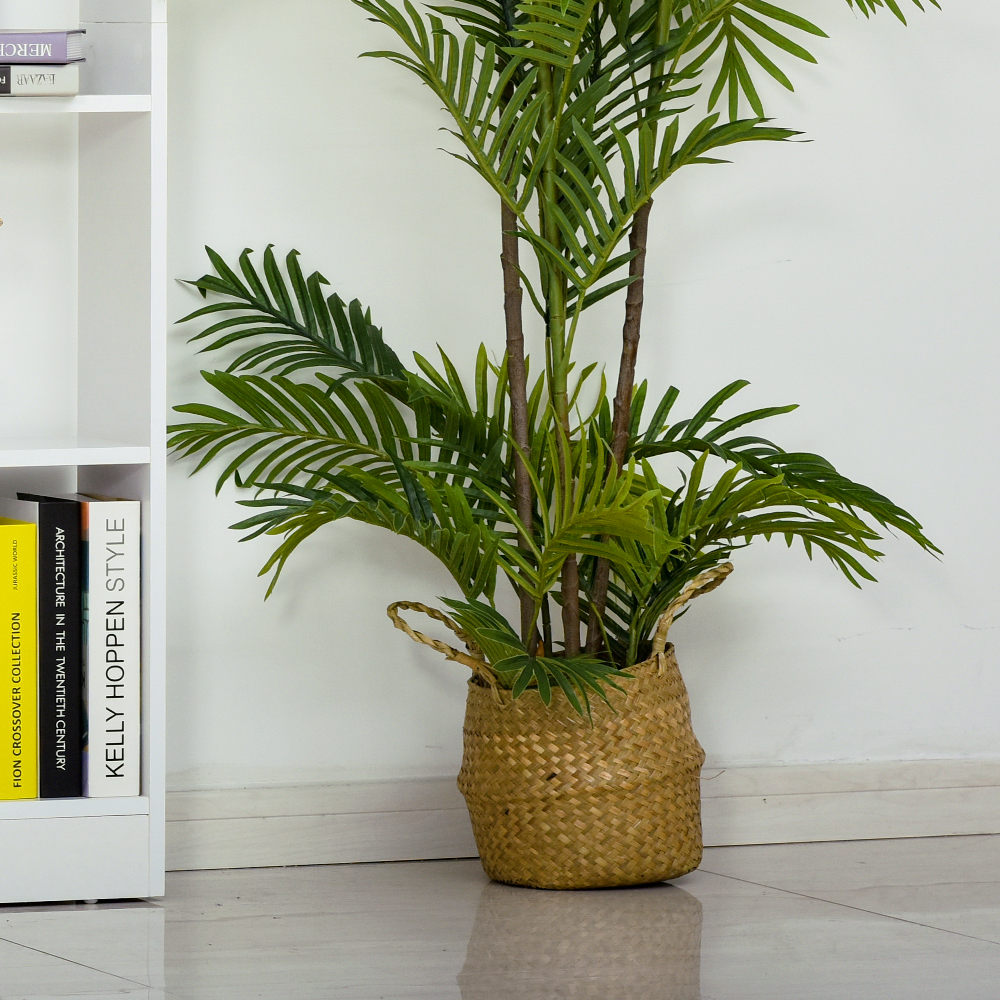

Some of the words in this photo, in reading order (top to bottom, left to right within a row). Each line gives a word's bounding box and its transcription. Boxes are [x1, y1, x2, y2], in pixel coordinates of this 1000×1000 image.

[55, 527, 66, 607] ARCHITECTURE
[106, 518, 124, 592] STYLE
[11, 612, 21, 684] COLLECTION
[55, 613, 66, 626] IN
[55, 630, 66, 651] THE
[106, 600, 124, 699] HOPPEN
[12, 686, 22, 756] CROSSOVER
[55, 656, 66, 718] TWENTIETH
[13, 757, 22, 788] FION
[55, 720, 66, 771] CENTURY
[106, 707, 124, 778] KELLY
